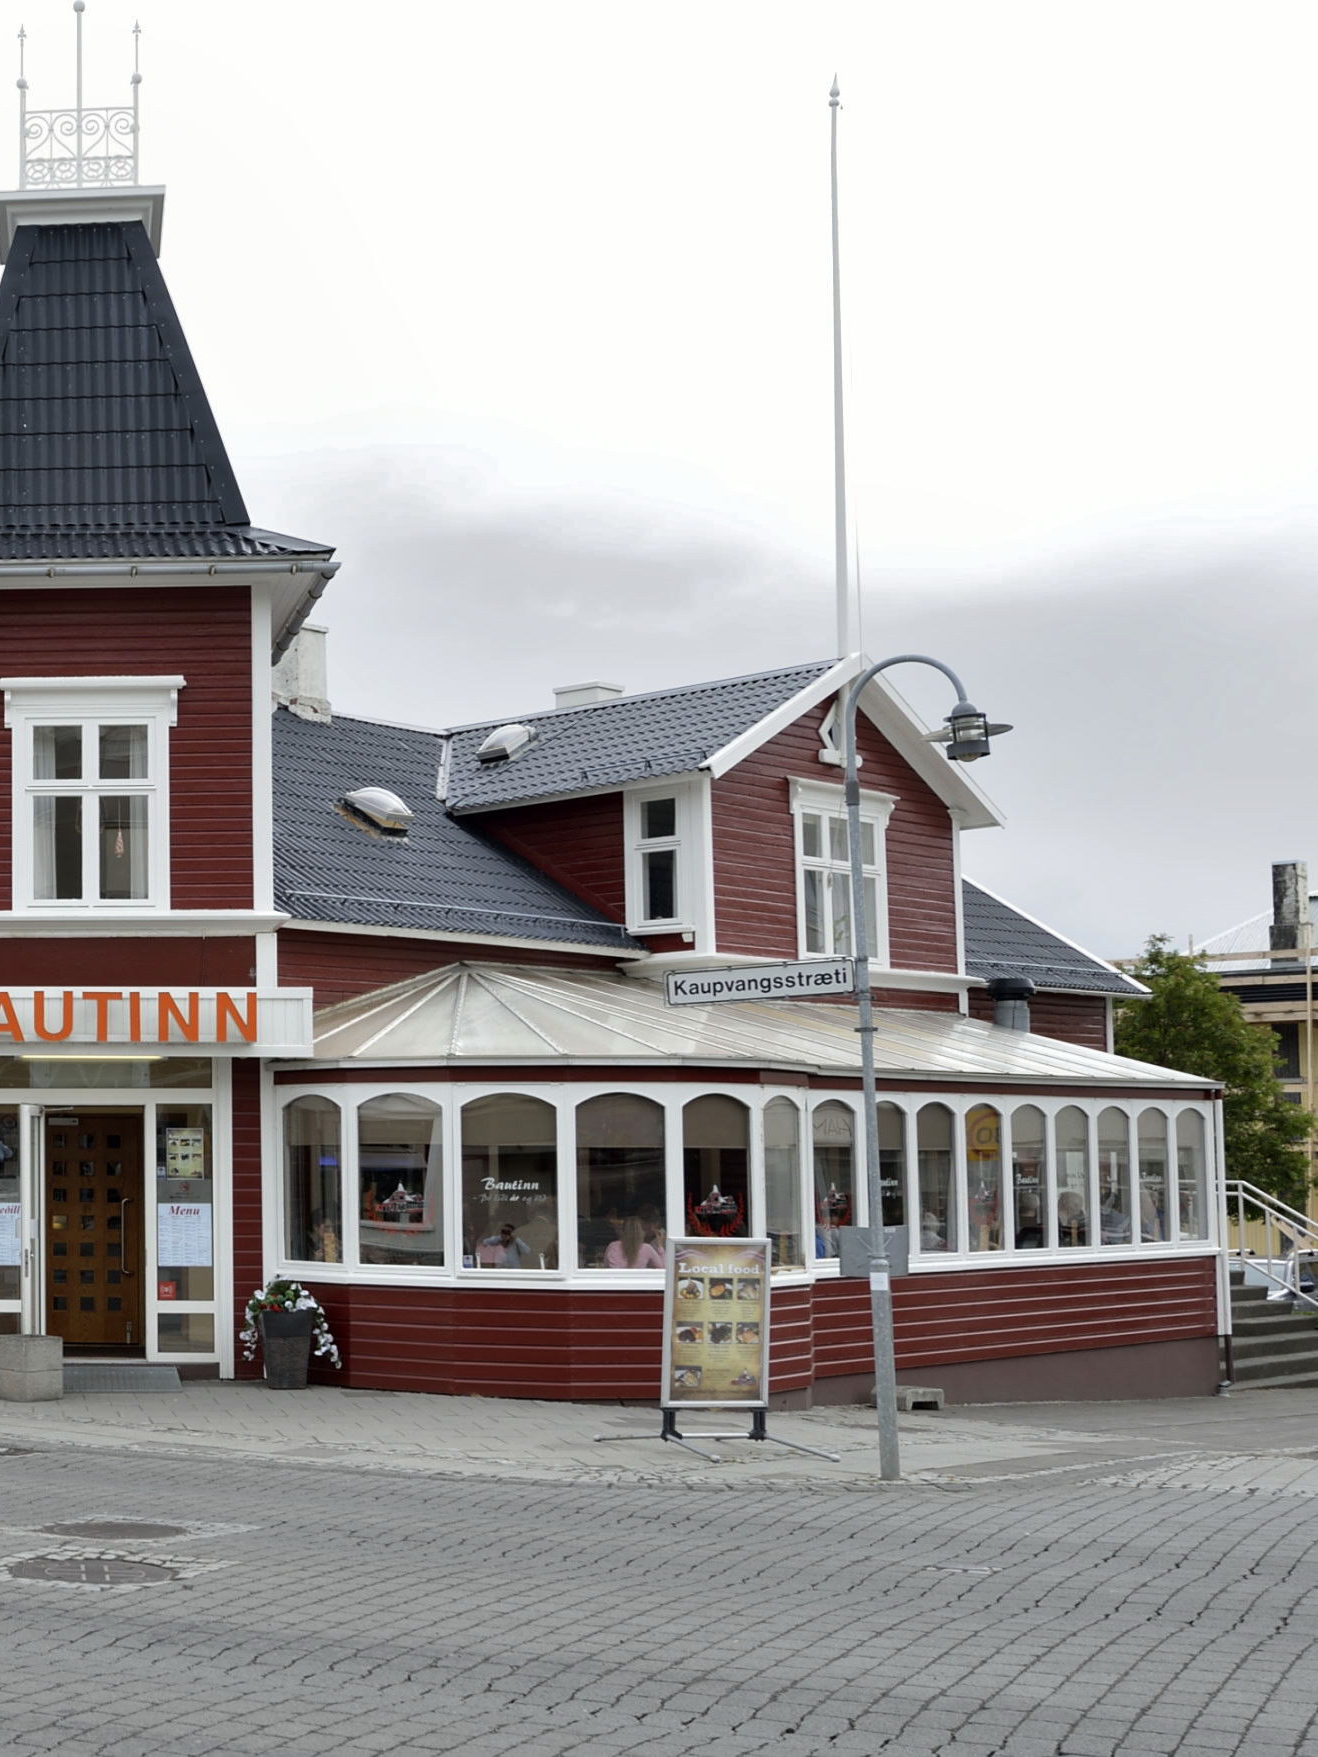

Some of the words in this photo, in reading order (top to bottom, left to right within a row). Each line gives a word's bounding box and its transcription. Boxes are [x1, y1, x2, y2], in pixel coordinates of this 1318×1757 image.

[674, 968, 847, 996] Kaupvangsstræti
[481, 1177, 539, 1190] Bautinn
[169, 1205, 201, 1216] Menu
[678, 1262, 724, 1274] Local
[728, 1263, 760, 1274] food
